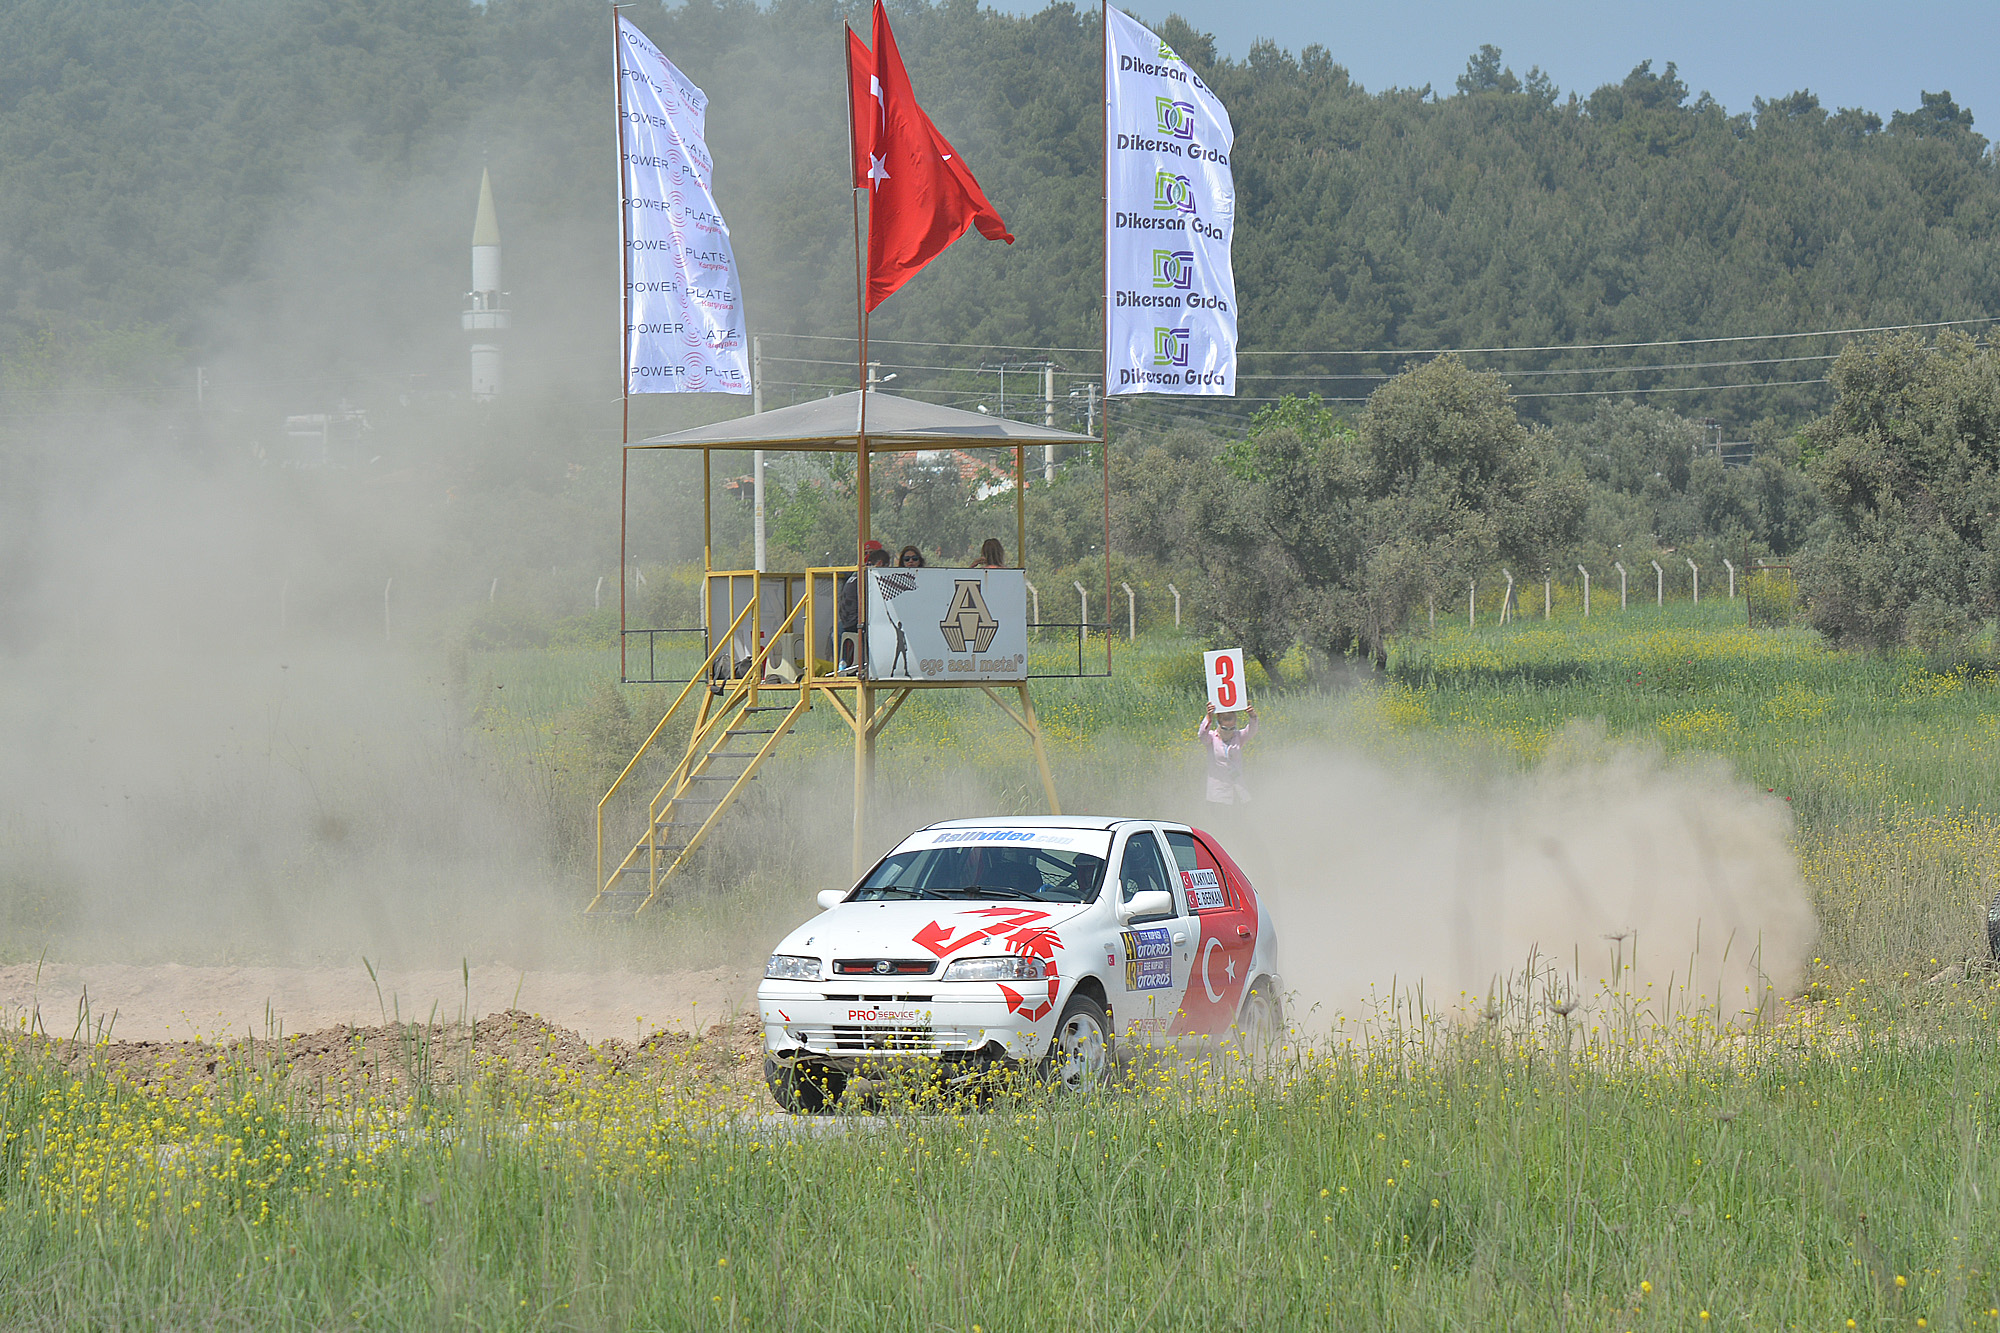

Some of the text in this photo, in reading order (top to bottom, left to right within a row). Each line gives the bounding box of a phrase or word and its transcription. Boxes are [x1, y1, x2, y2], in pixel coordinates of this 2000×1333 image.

[1120, 55, 1187, 83] Dikersan
[621, 112, 667, 130] POWER
[1117, 134, 1182, 157] Dikersan
[623, 154, 669, 170] POWER
[624, 198, 671, 213] POWER
[1115, 212, 1186, 231] Dikersan
[627, 281, 678, 293] POWER
[1116, 290, 1228, 312] Dikersan Gıda
[628, 323, 684, 335] POWER
[630, 366, 686, 378] POWER
[1119, 369, 1180, 386] Dikersan
[920, 658, 944, 676] ege
[948, 654, 976, 672] asal
[1215, 655, 1237, 707] 3
[1137, 943, 1170, 958] OTOKROS
[1126, 961, 1137, 990] 43
[1137, 973, 1170, 988] OTOKROS
[848, 1010, 877, 1021] PRO
